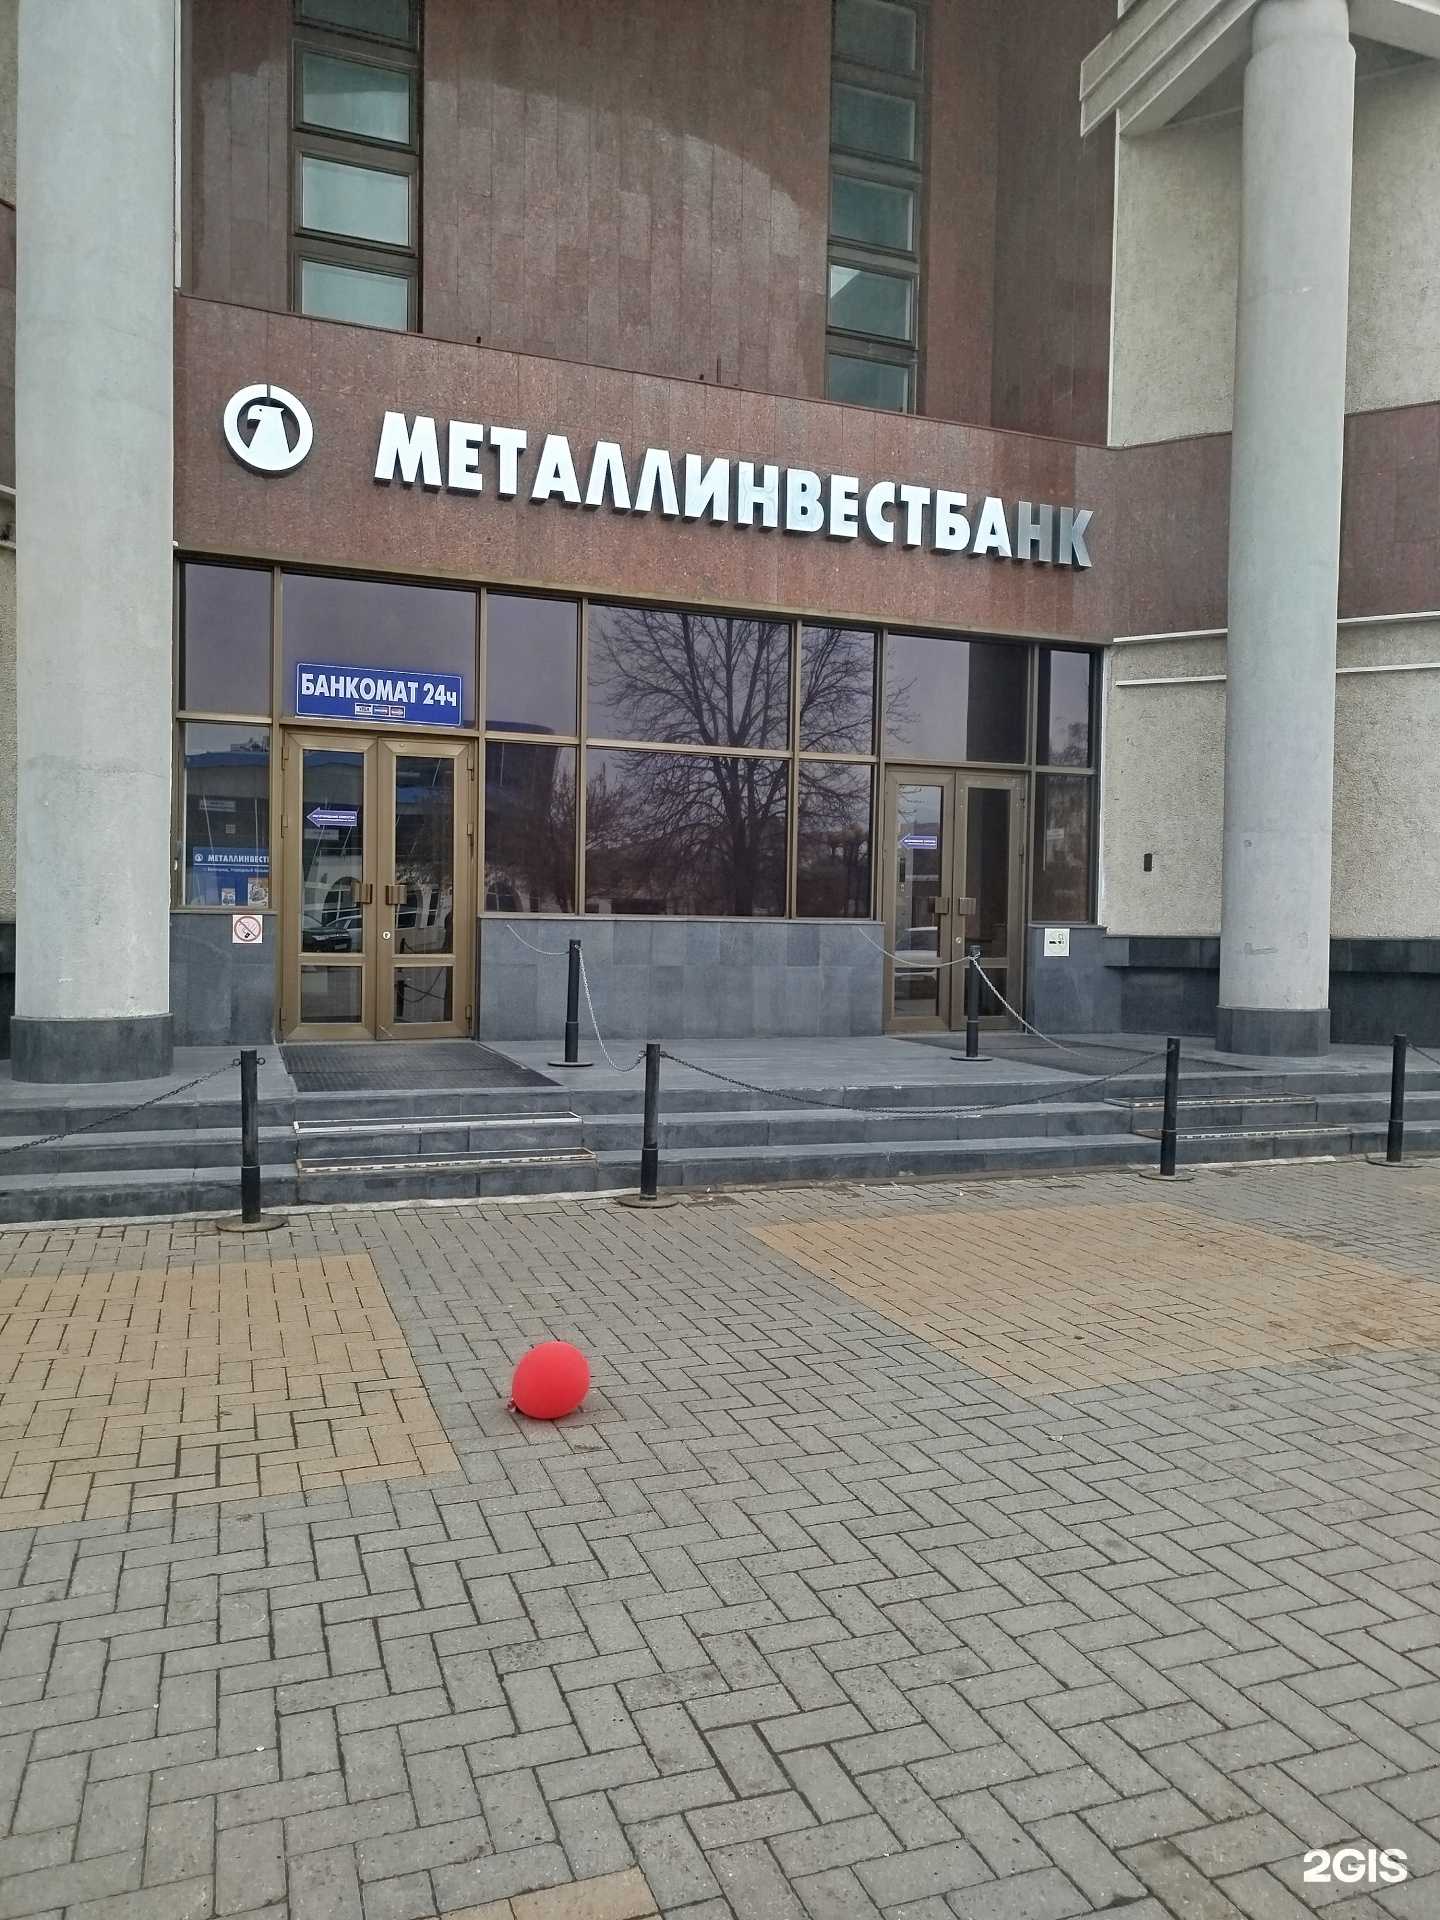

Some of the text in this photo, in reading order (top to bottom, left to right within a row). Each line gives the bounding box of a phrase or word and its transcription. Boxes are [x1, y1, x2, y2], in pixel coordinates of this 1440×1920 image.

[374, 411, 1094, 568] МЕТАЛЛИНВЕСТБАНК
[301, 673, 457, 706] БАНКОМАТ 24ч
[207, 854, 269, 864] МЕТАЛЛИНВЕСТ
